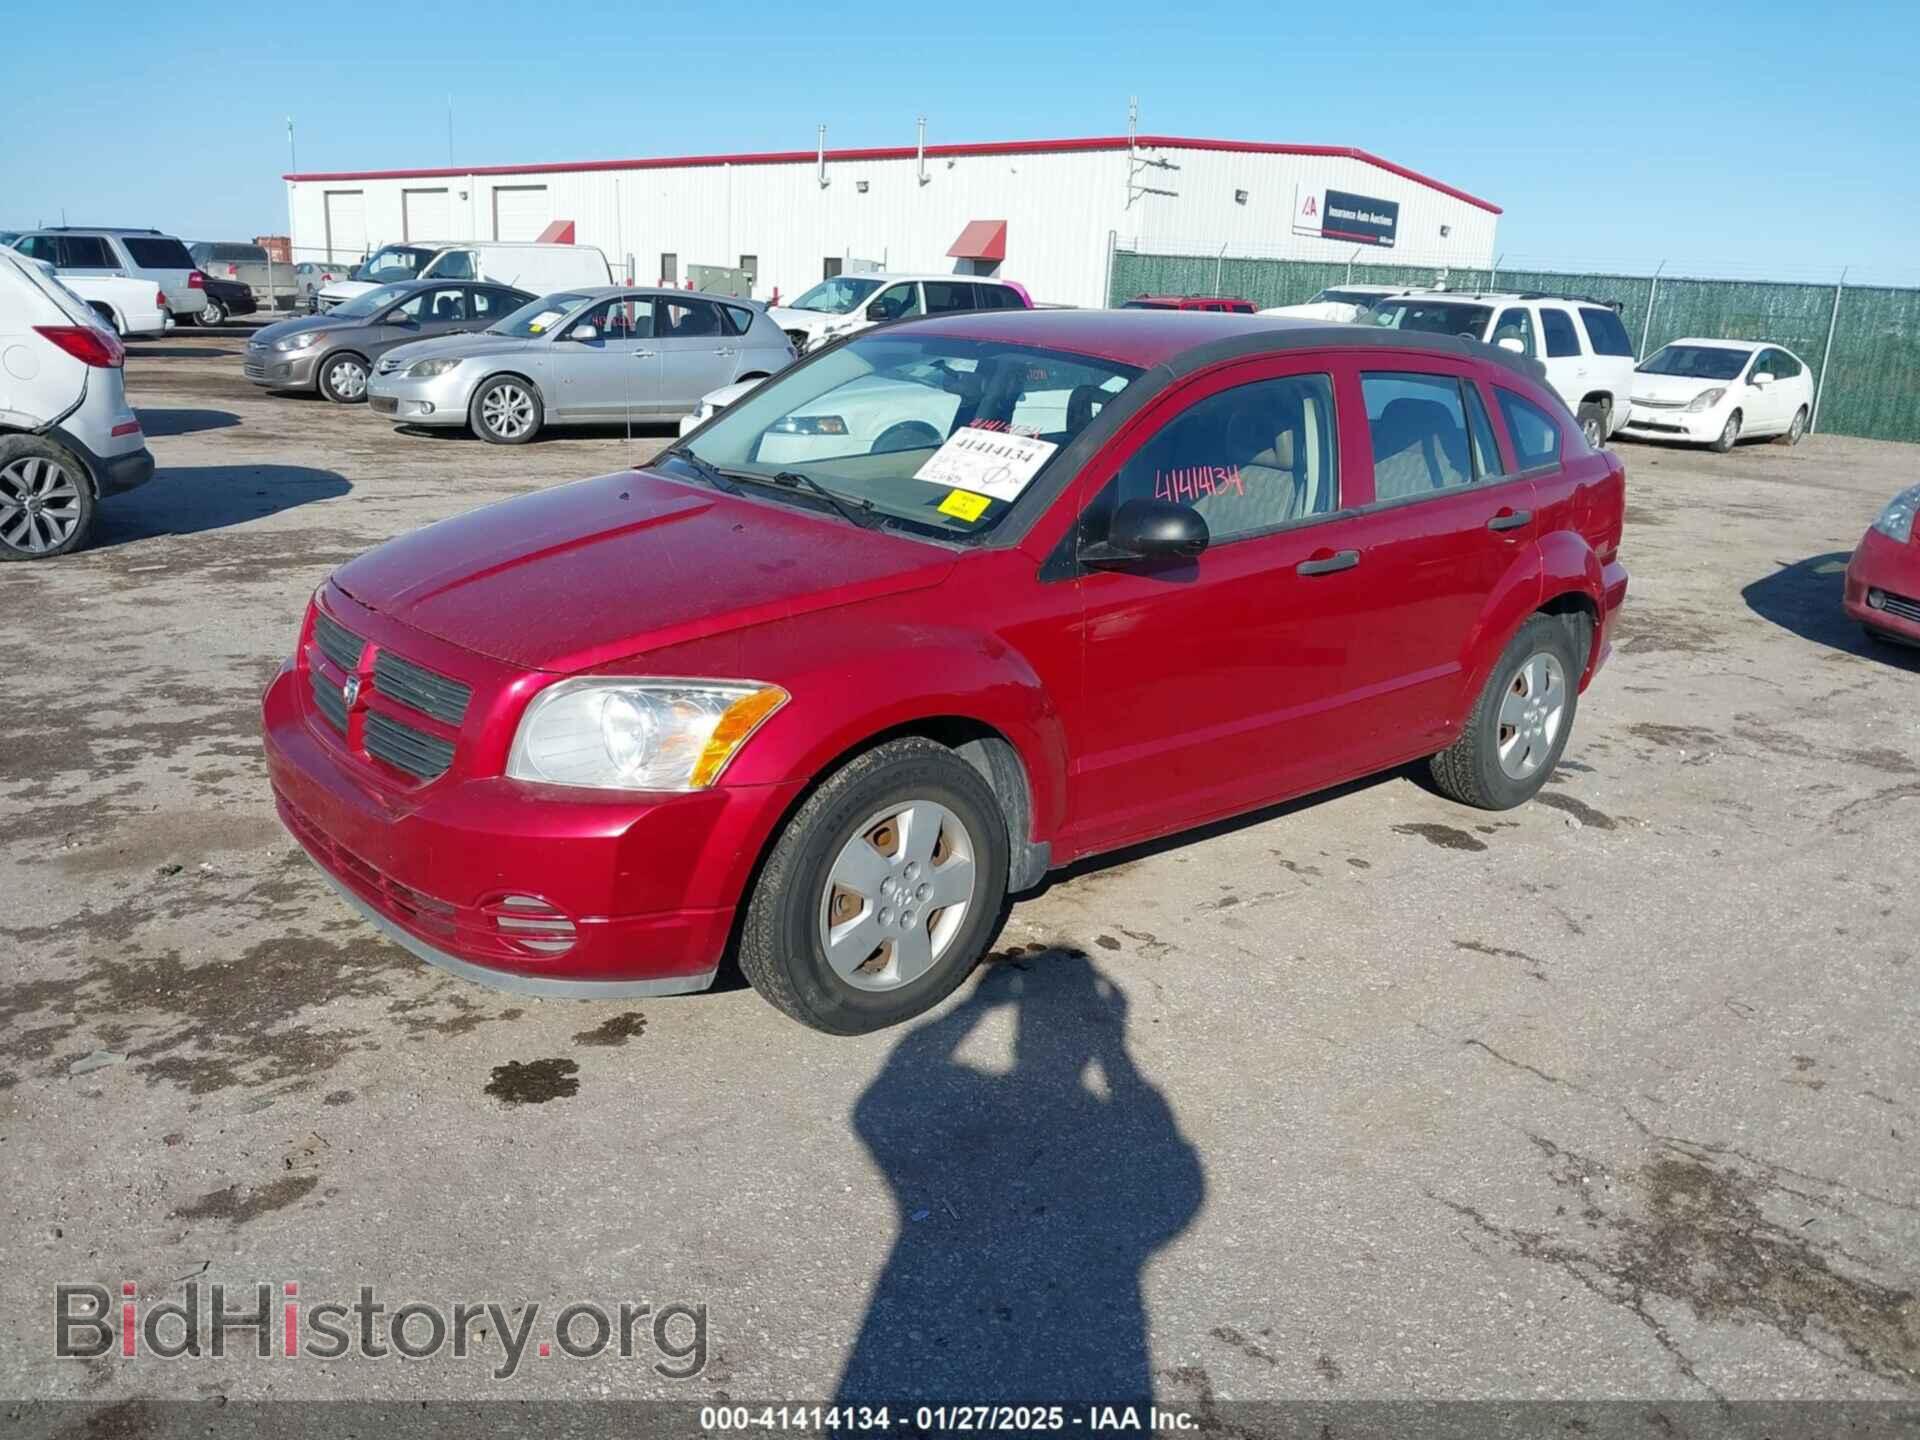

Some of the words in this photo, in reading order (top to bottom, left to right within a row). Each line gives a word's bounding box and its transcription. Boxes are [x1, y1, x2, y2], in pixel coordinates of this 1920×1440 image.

[1328, 204, 1356, 220] Insurance
[1357, 209, 1370, 223] Auto
[1370, 212, 1393, 227] Auctions
[956, 437, 1035, 463] 41414134
[1155, 464, 1244, 503] 41414134
